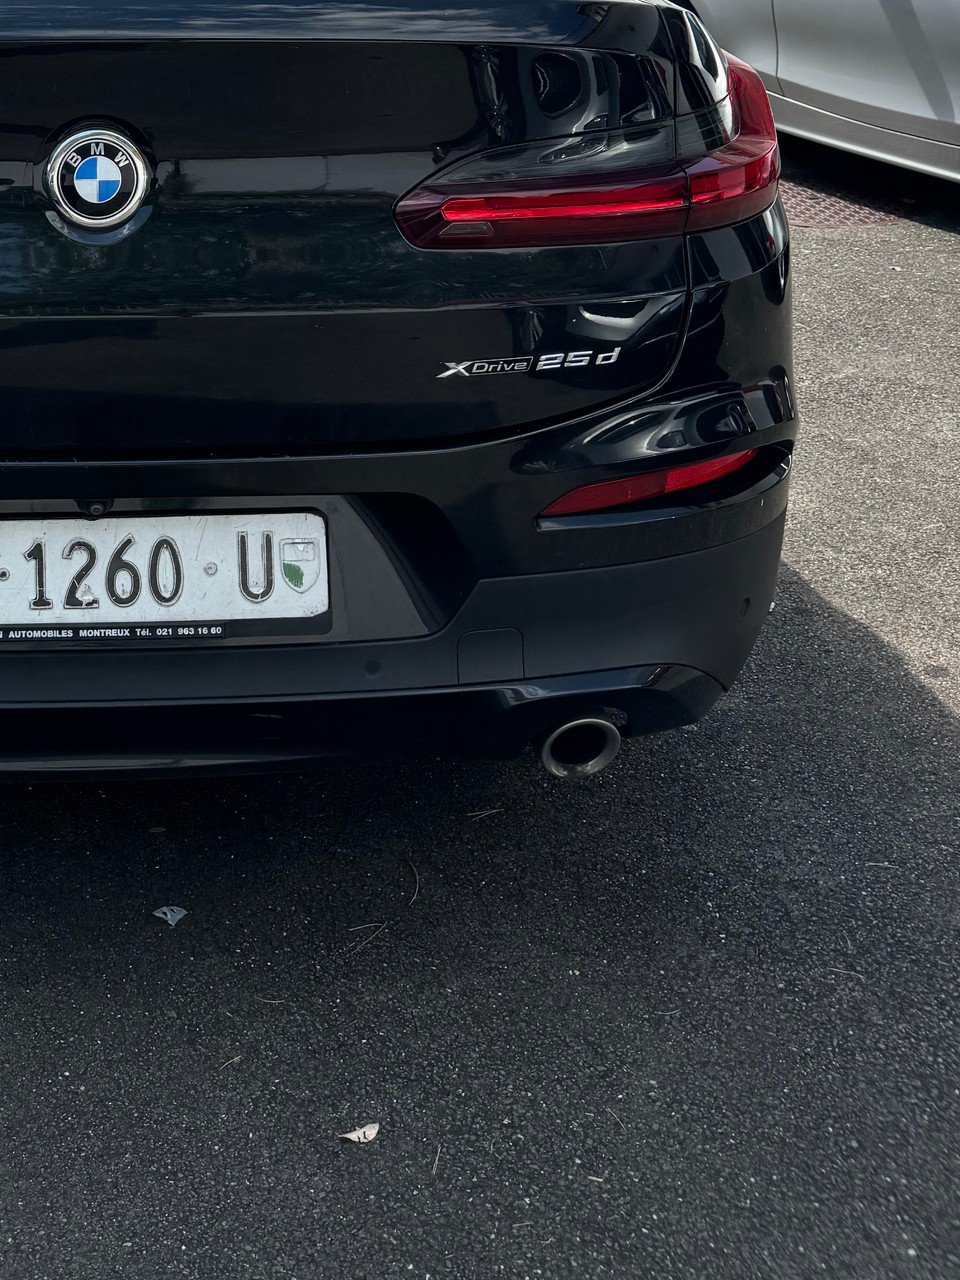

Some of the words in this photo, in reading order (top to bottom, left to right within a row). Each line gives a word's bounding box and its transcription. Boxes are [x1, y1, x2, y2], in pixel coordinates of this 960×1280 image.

[66, 142, 130, 168] BMW
[238, 530, 276, 603] U
[8, 629, 74, 639] AUTOMOBILES
[79, 628, 130, 637] MONTREUX
[135, 627, 152, 636] Tél.
[156, 627, 173, 636] 021
[177, 627, 195, 636] 963
[197, 627, 209, 635] 16
[210, 626, 222, 635] 60
